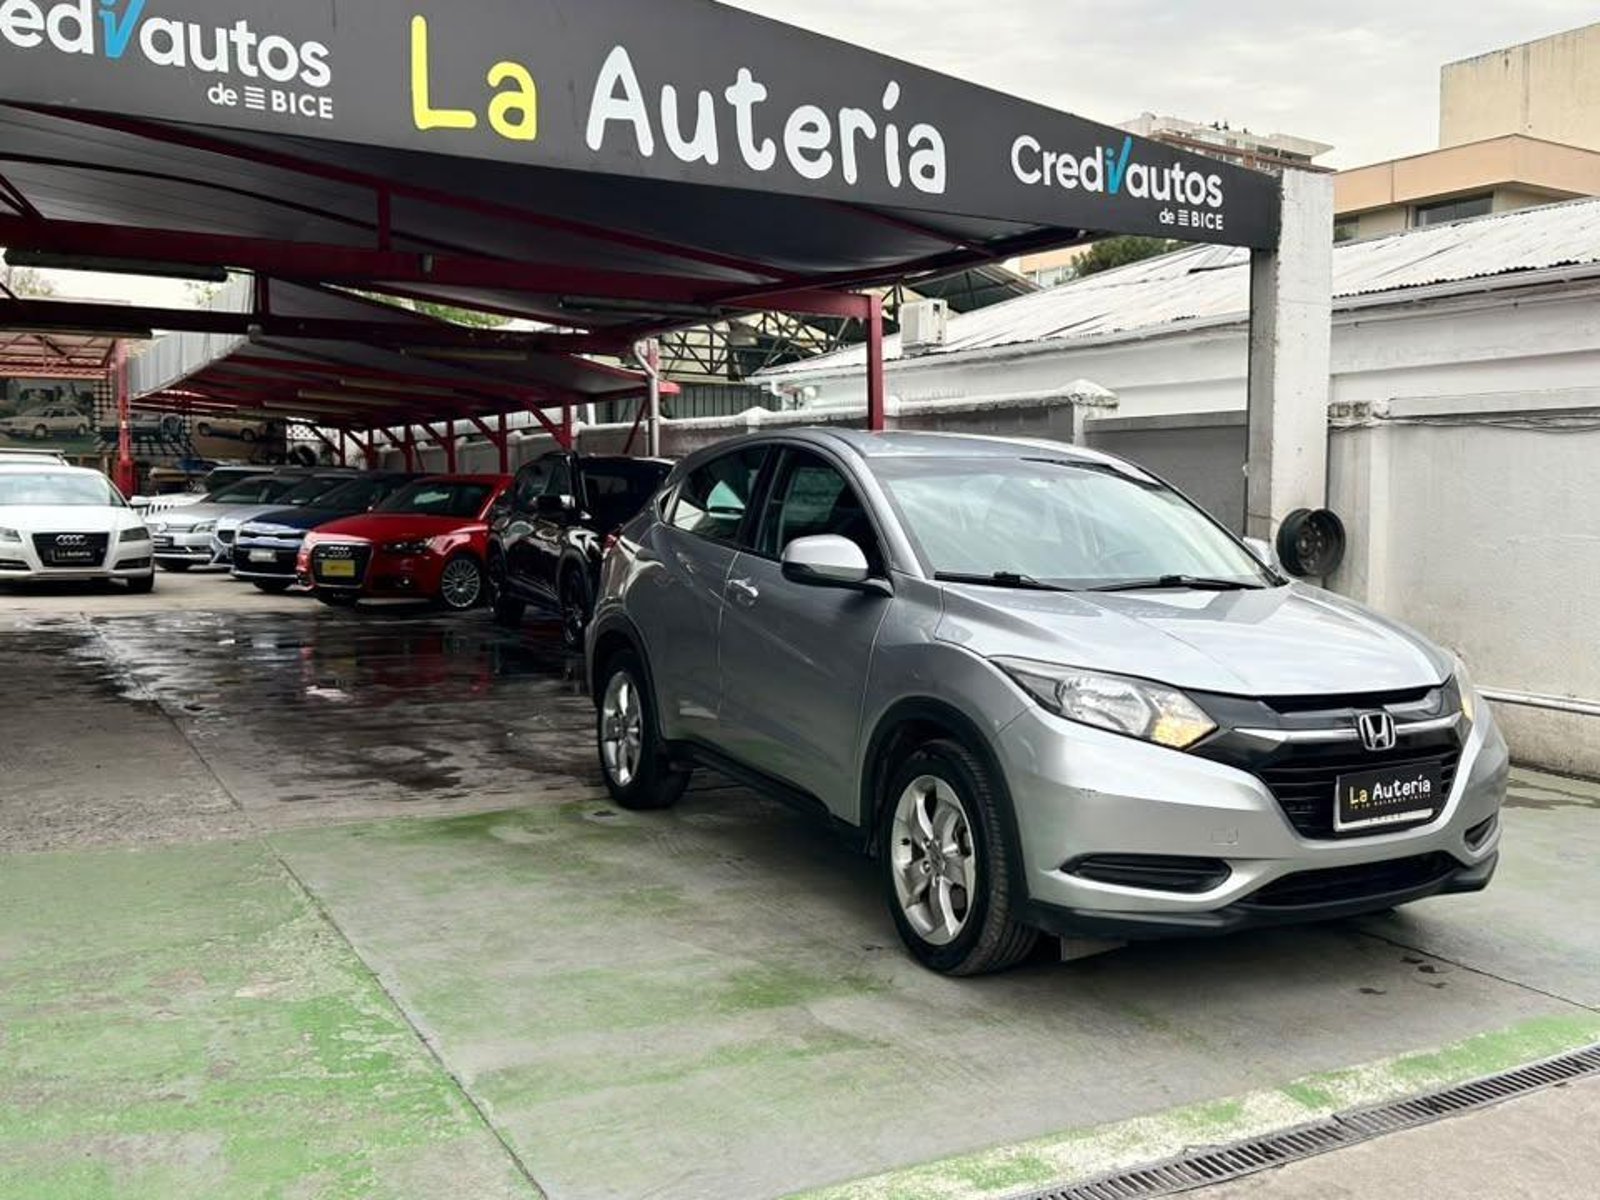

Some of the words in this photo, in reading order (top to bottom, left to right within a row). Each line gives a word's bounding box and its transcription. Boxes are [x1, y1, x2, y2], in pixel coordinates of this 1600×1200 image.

[207, 82, 237, 106] de
[271, 90, 334, 119] BICE
[411, 15, 537, 141] La
[586, 46, 946, 194] Autería
[1159, 208, 1175, 225] de
[1191, 211, 1224, 230] BICE
[1349, 786, 1368, 804] La
[1372, 774, 1431, 800] Autería
